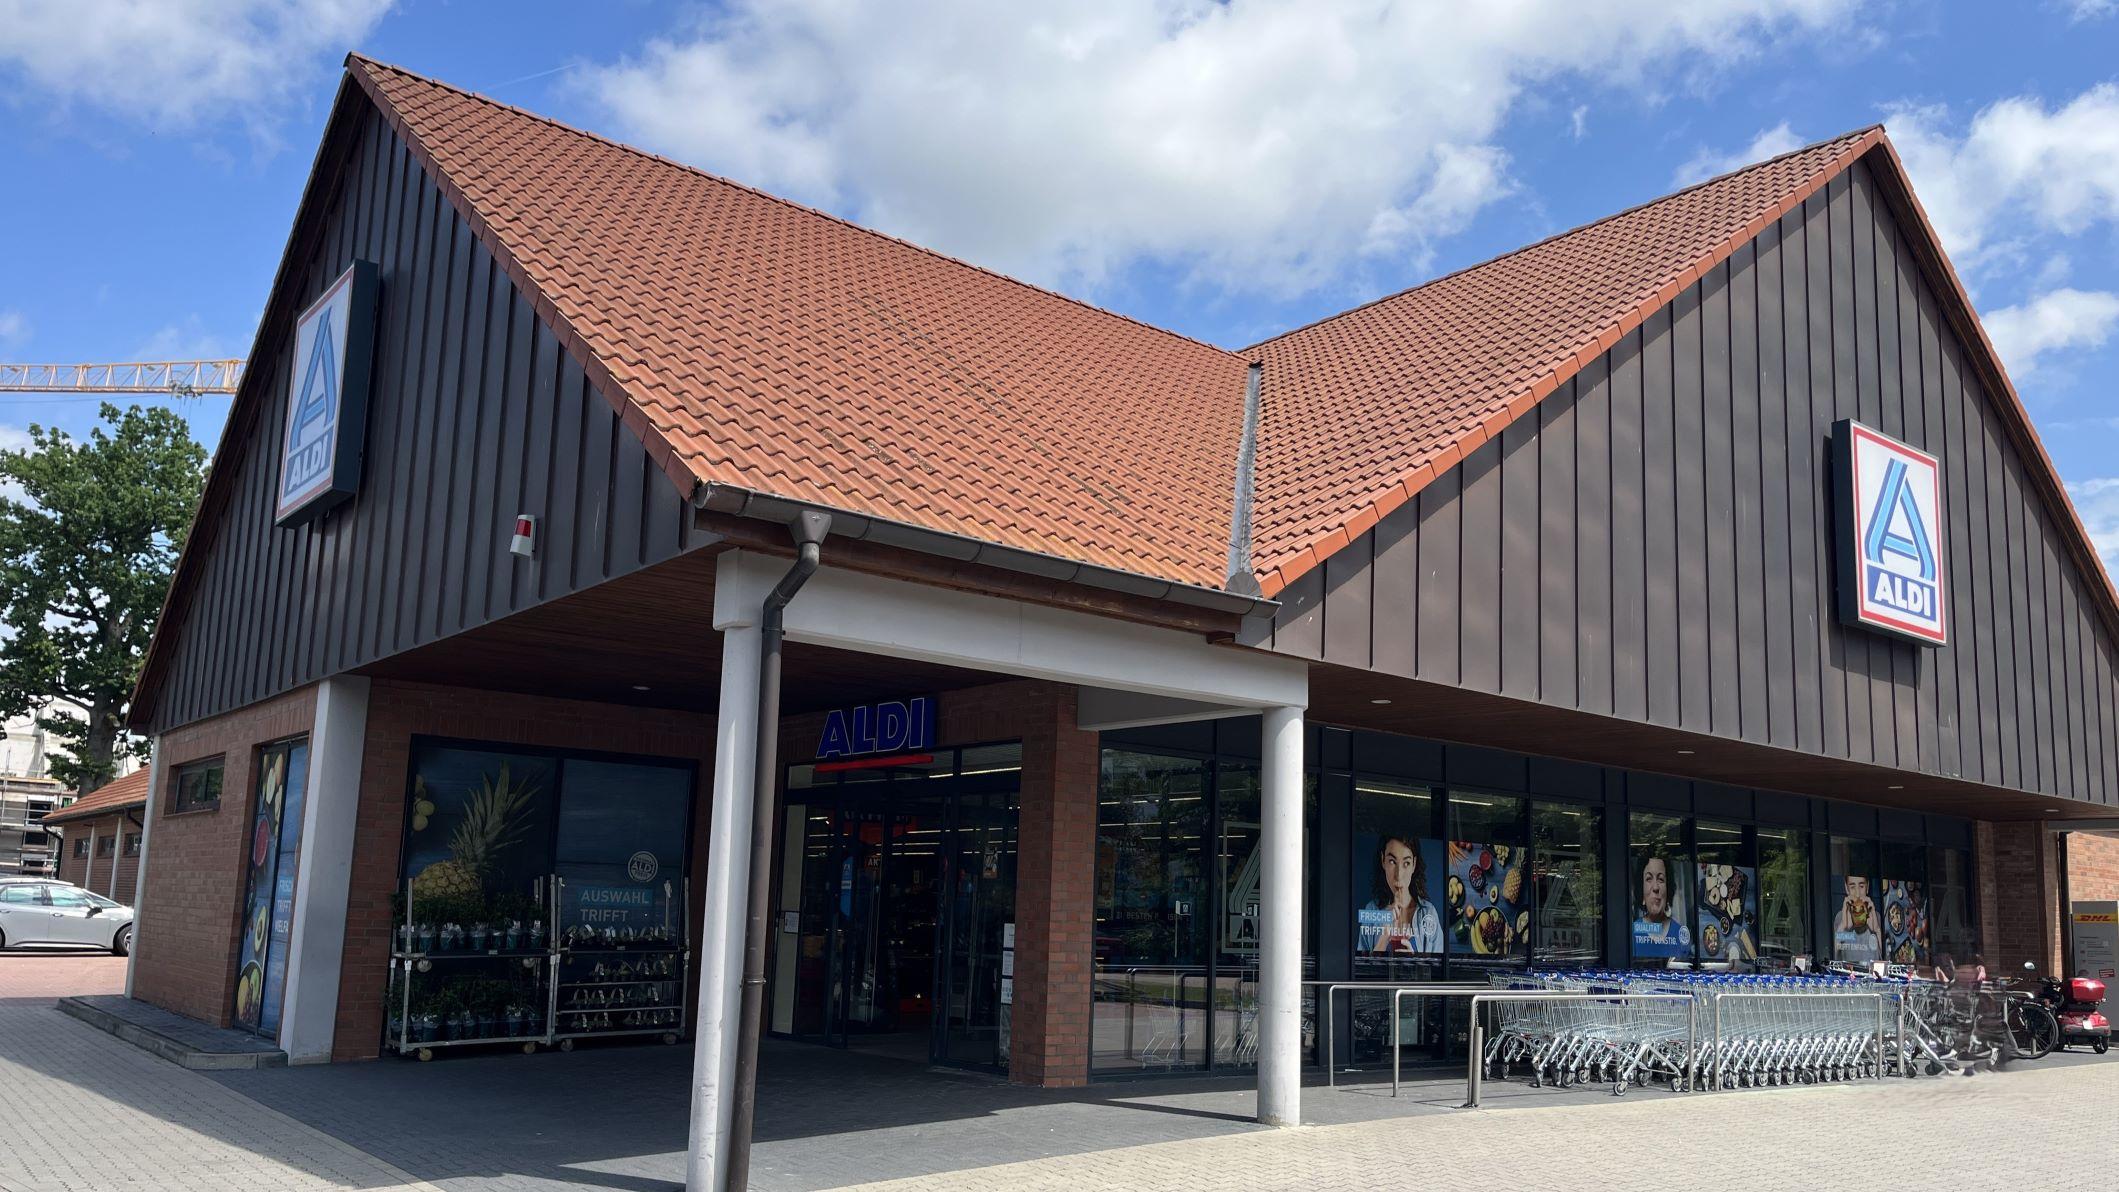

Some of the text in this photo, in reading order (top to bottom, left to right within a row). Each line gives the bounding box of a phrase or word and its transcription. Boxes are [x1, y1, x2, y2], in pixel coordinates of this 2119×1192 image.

[287, 434, 329, 491] ALDI
[1874, 572, 1931, 617] ALDI
[815, 697, 927, 759] ALDI
[580, 889, 650, 904] AUSWAHL
[579, 908, 628, 922] TRIFFT
[1360, 911, 1391, 922] FRISCHE
[1360, 925, 1385, 936] TRIFFT
